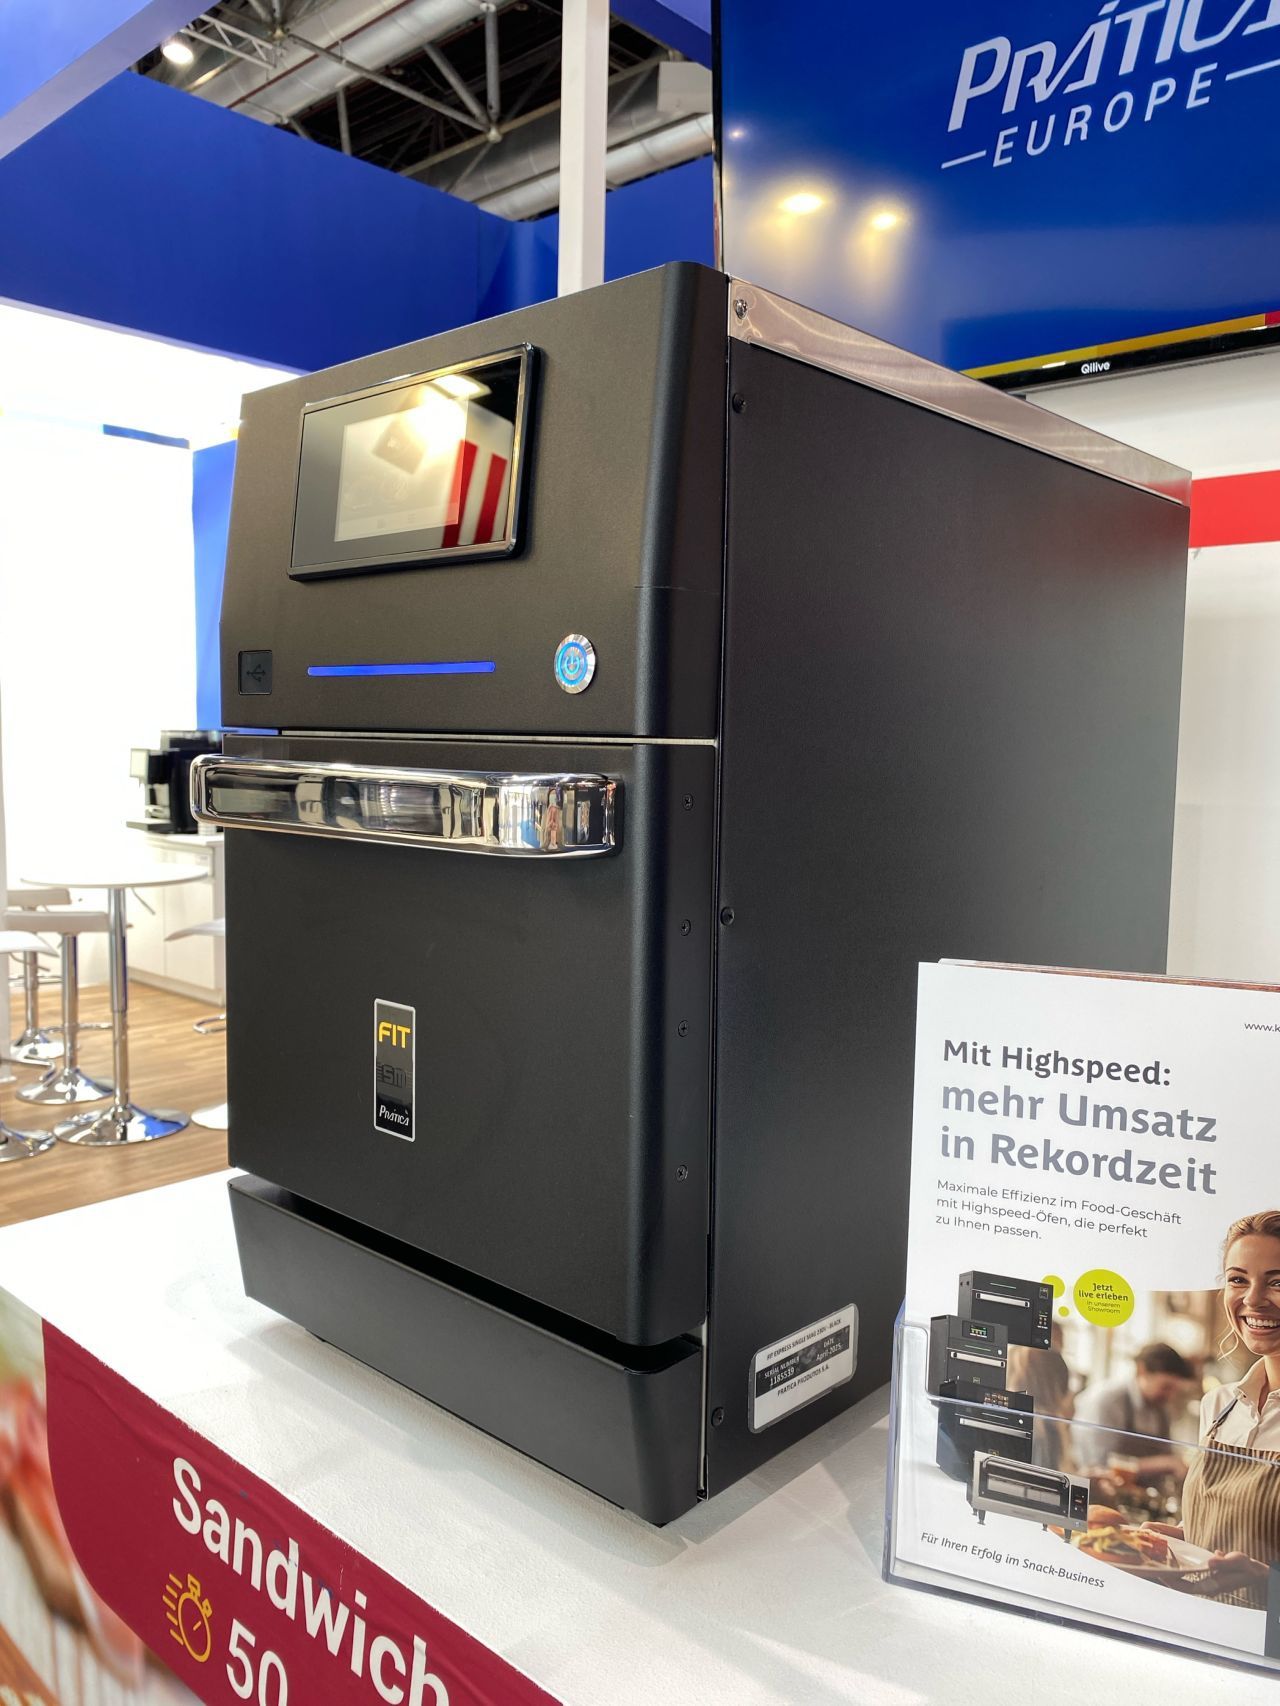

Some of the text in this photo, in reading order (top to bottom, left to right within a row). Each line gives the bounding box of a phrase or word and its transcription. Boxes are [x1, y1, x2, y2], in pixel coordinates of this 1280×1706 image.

[993, 63, 1219, 167] EUROPE
[1081, 361, 1110, 374] Qilive
[378, 1021, 411, 1049] FIT
[943, 1039, 1171, 1086] Mit Highspeed:
[942, 1085, 1217, 1143] mehr Umsatz
[941, 1126, 1217, 1195] in Rekordzeit
[936, 1197, 1148, 1238] mit Highspeed-Öfen, die perfekt
[937, 1179, 1182, 1225] Maximale Effizienz im Food-Geschäft
[935, 1215, 1042, 1240] zu Ihnen passen.
[1093, 1283, 1113, 1291] Jetzt
[1096, 1292, 1129, 1301] erleben
[774, 1343, 792, 1356] EXPRESS
[172, 1457, 450, 1706] Sandwich
[920, 1532, 1105, 1588] Für Ihren Erfolg im Snack-Business
[226, 1617, 288, 1706] 50
